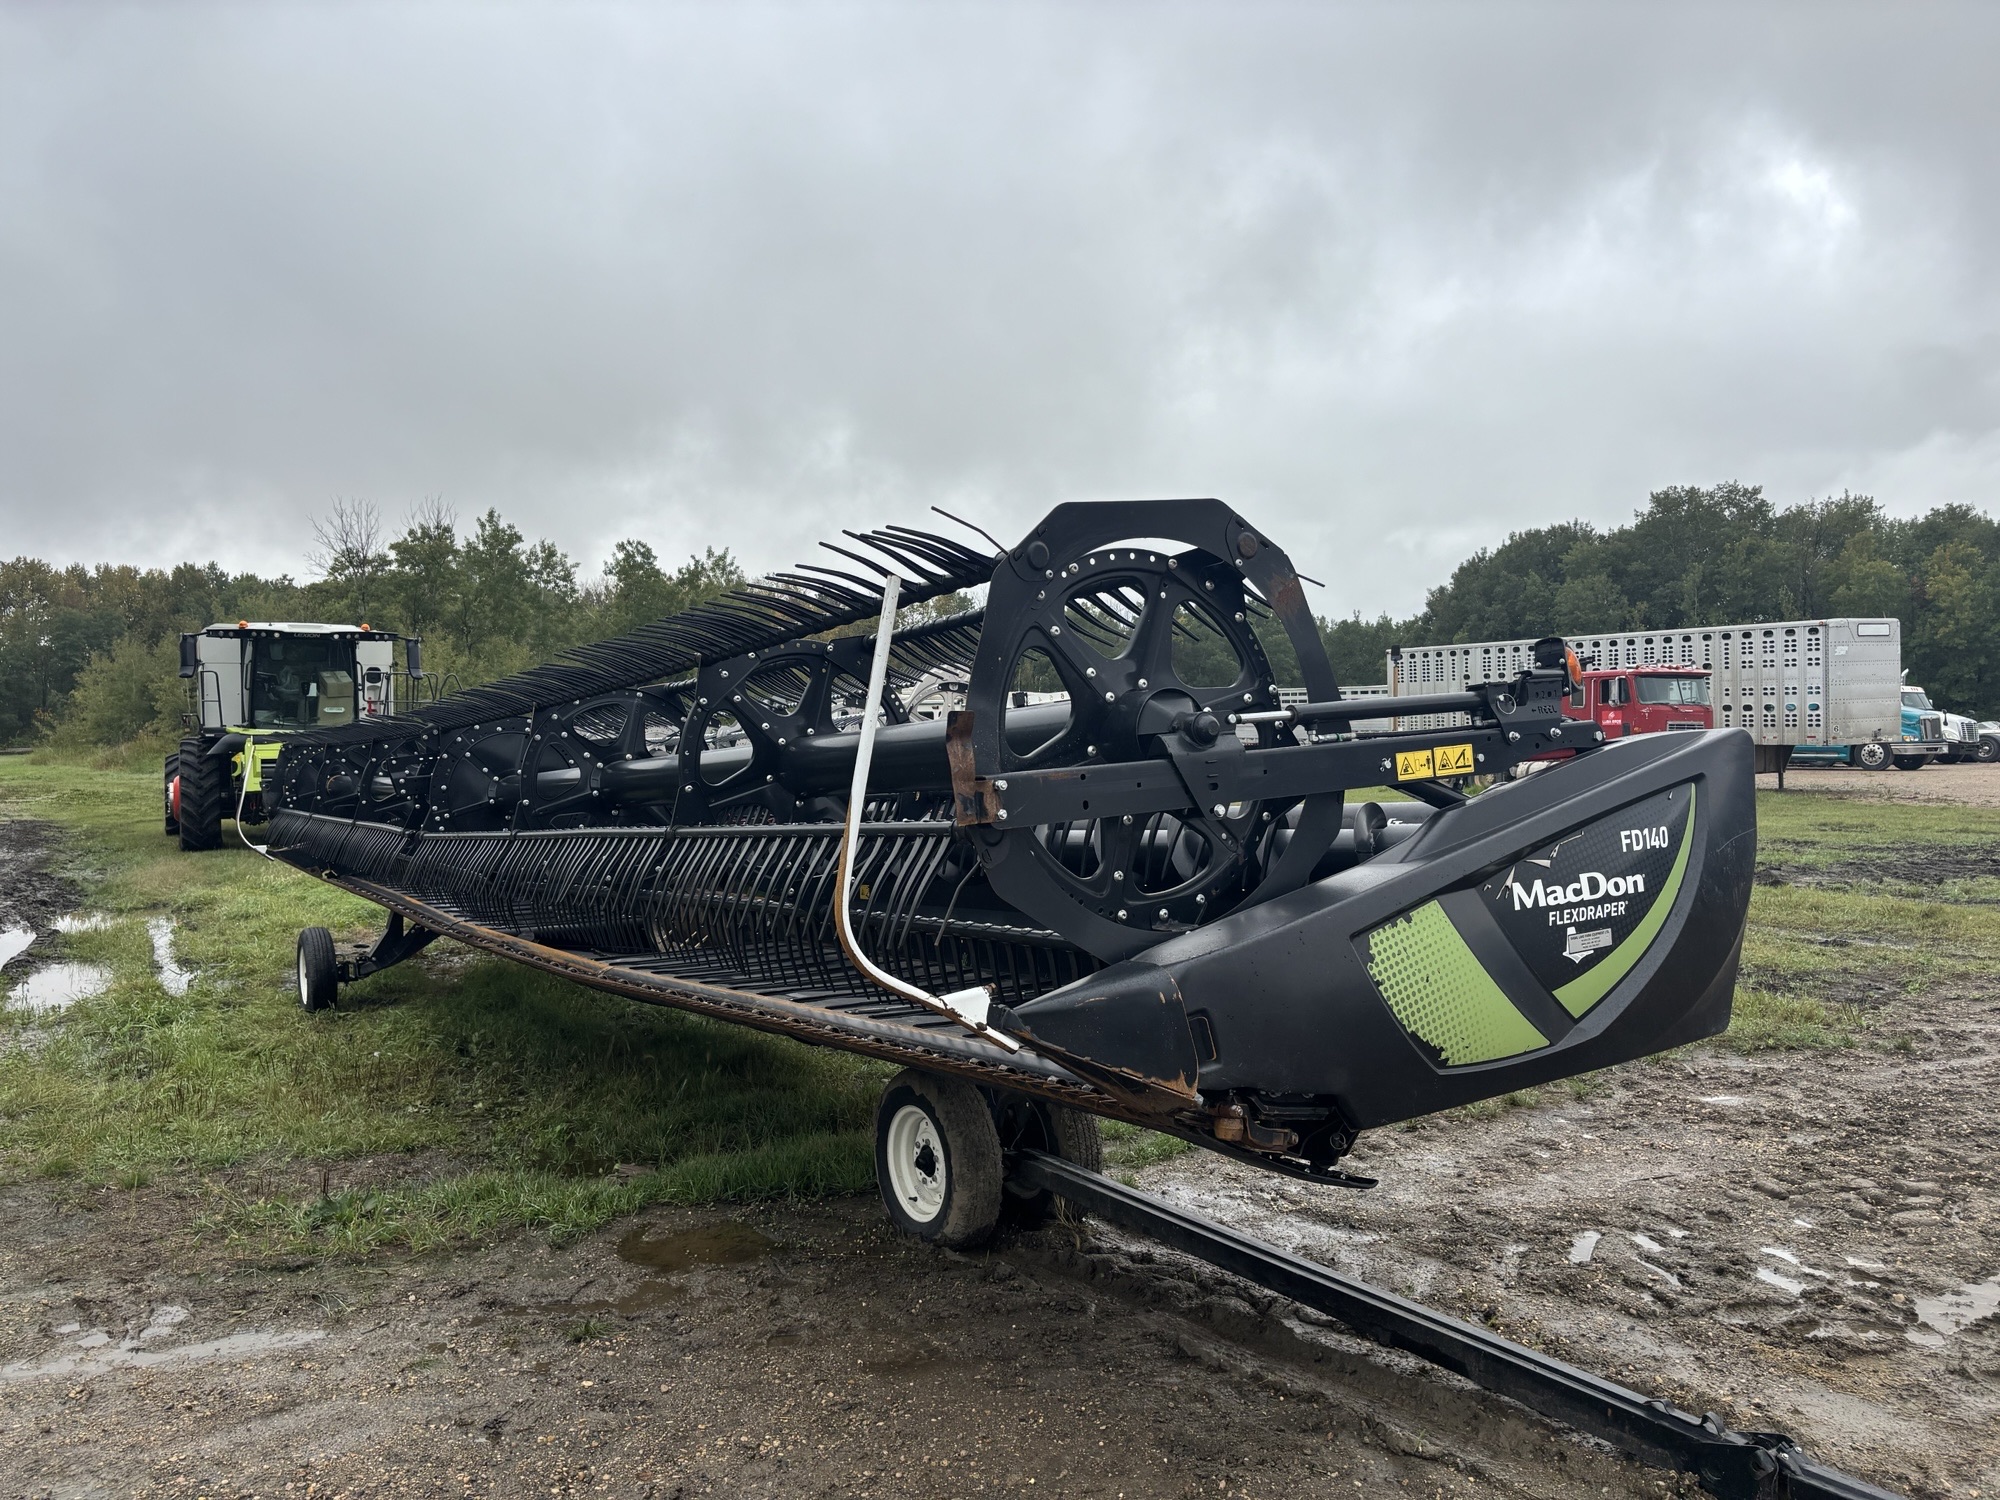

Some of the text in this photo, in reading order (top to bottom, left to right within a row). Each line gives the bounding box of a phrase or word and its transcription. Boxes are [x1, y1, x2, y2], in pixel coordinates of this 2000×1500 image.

[1620, 826, 1669, 852] FD140
[1512, 872, 1645, 911] MacDon
[1548, 903, 1626, 927] FLEXDRAPER
